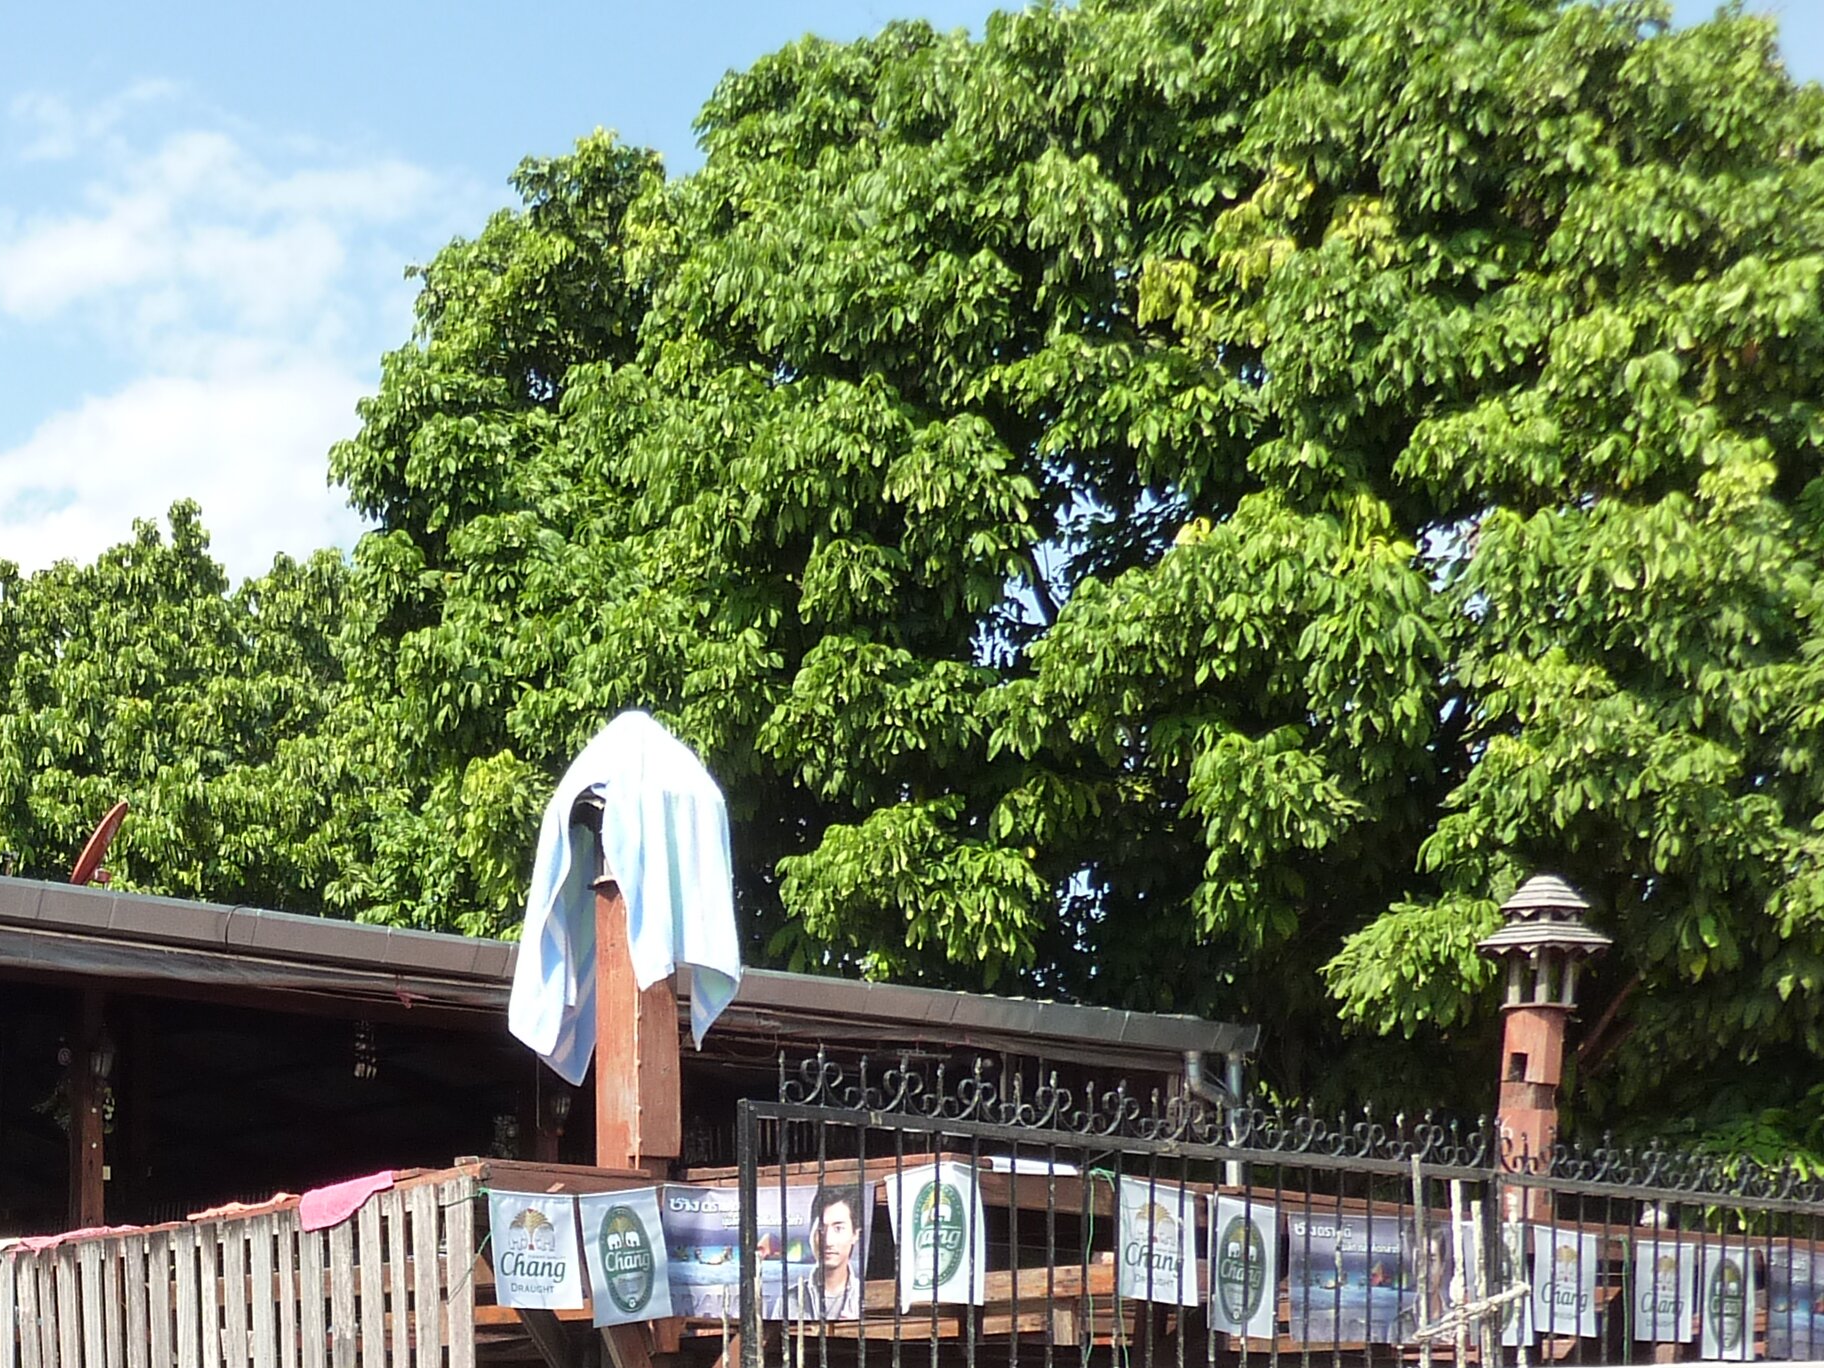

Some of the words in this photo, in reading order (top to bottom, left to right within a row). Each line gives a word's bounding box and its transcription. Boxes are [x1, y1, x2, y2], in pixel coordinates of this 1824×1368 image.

[500, 1251, 567, 1283] Chang
[605, 1250, 651, 1272] Chang
[511, 1282, 555, 1294] DRAUGHT
